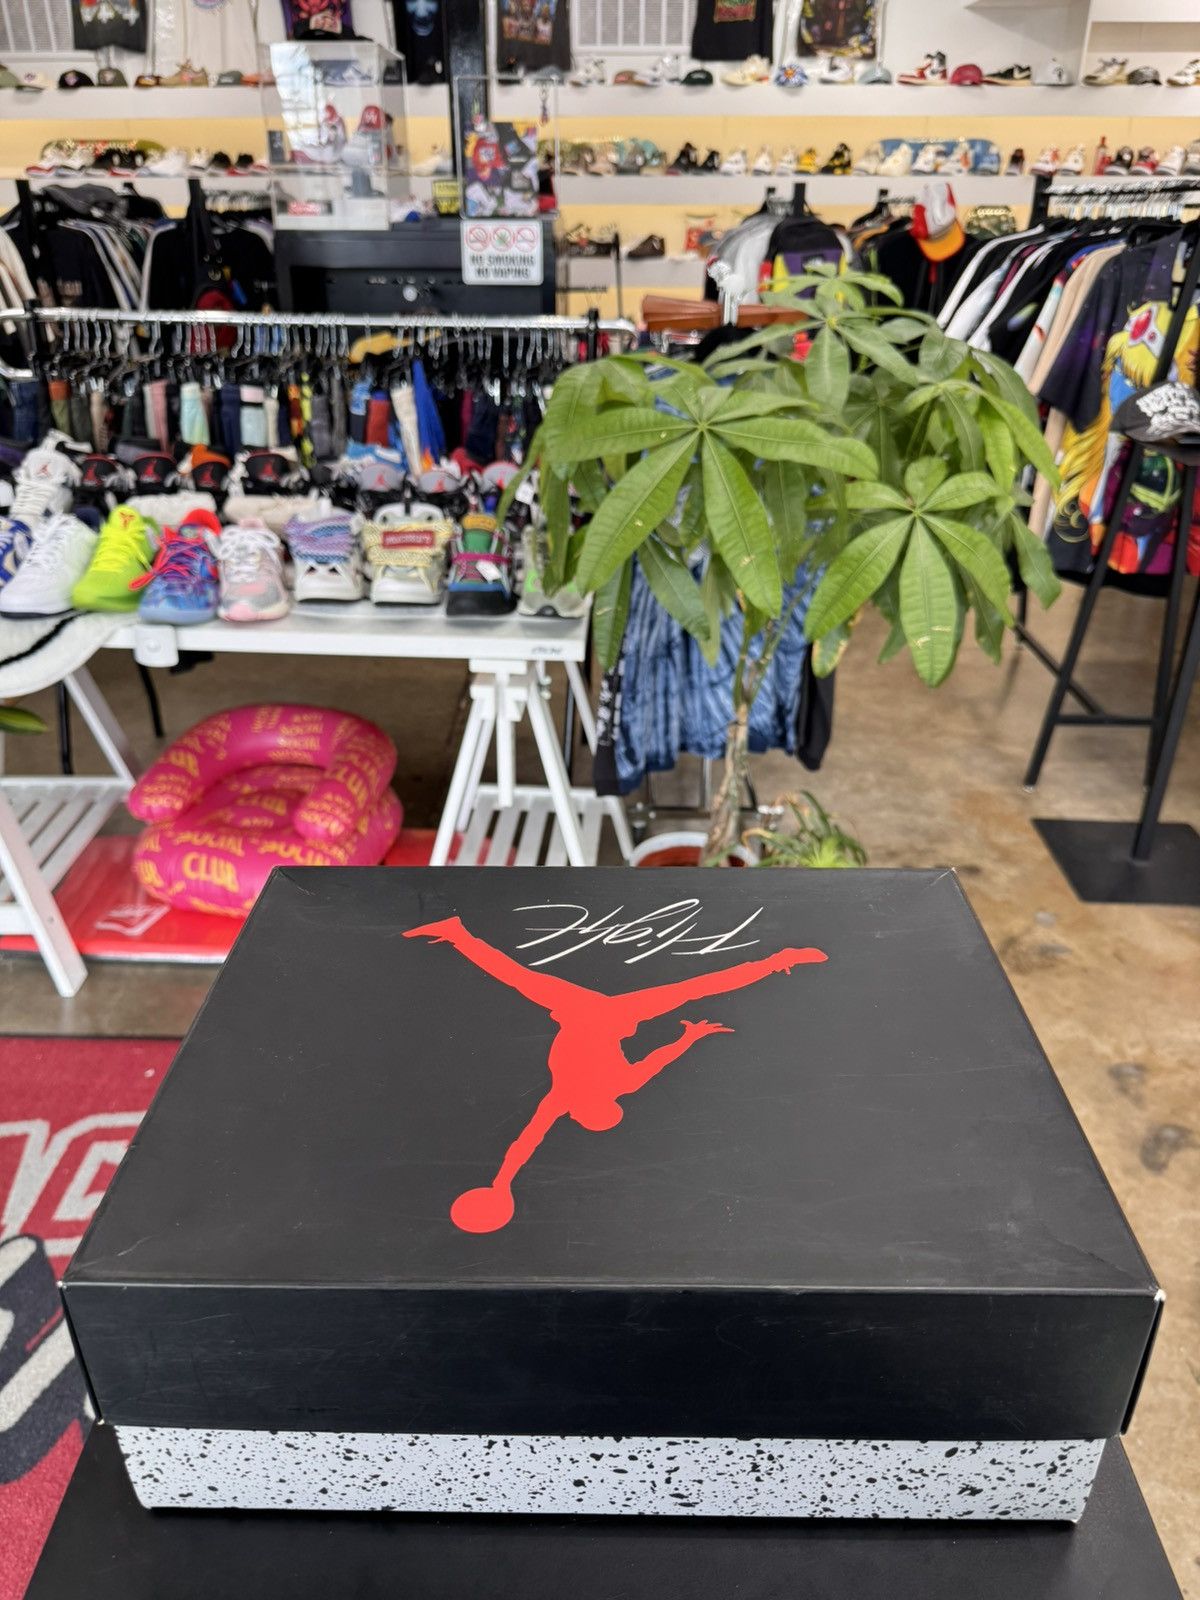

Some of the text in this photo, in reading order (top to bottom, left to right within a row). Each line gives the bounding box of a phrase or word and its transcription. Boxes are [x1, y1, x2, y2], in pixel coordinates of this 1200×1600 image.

[471, 255, 535, 266] NO SMOKING
[476, 267, 530, 278] NO VAPING
